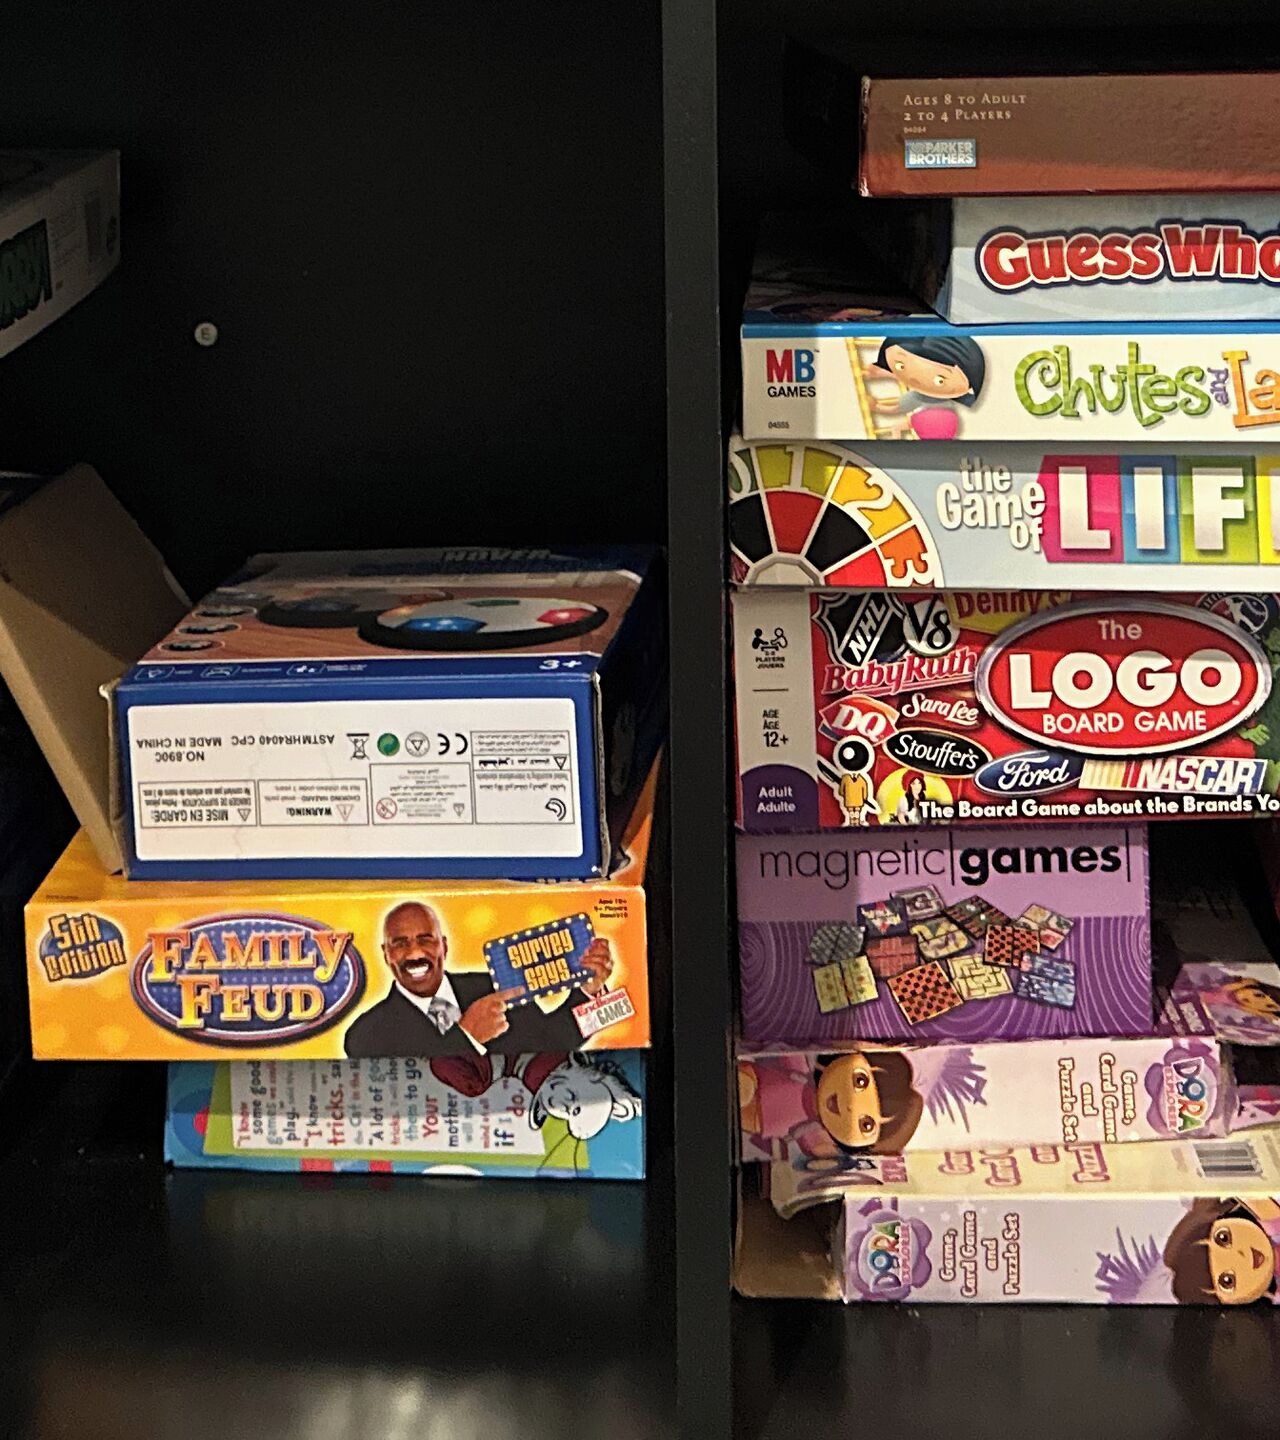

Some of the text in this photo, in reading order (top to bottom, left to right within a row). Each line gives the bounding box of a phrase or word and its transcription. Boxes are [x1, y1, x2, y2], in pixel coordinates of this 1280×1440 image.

[909, 153, 974, 167] BROTHERS
[765, 347, 816, 383] MB
[767, 385, 816, 399] GAMES
[1014, 341, 1214, 428] Chutes
[959, 456, 1012, 491] the
[936, 479, 1046, 530] Game
[1009, 513, 1043, 552] of
[848, 598, 887, 663] NHL
[906, 601, 953, 651] V8
[1097, 619, 1143, 641] The
[1009, 649, 1243, 709] LOGO
[763, 732, 789, 748] 12+
[833, 704, 886, 739] DQ
[1042, 710, 1207, 734] BOARD GAME
[895, 734, 979, 770] Stouffer's
[998, 755, 1070, 791] Ford
[1137, 758, 1256, 793] NASCAR
[758, 786, 793, 798] Adult
[920, 800, 954, 818] The
[958, 800, 1018, 818] Board
[1022, 799, 1077, 817] Game
[1083, 797, 1143, 815] about
[1146, 796, 1180, 813] the
[1183, 795, 1253, 812] Brands
[286, 807, 332, 816] WARNING:
[760, 840, 1122, 889] magnetic games
[48, 913, 101, 950] 5th
[147, 930, 354, 982] FAMILY
[176, 974, 324, 1028] FEUD
[1100, 1053, 1118, 1143] Card Game
[1122, 1071, 1137, 1125] Game,
[1172, 1058, 1205, 1132] DORA
[422, 1095, 439, 1138] Your
[441, 1092, 459, 1147] mother
